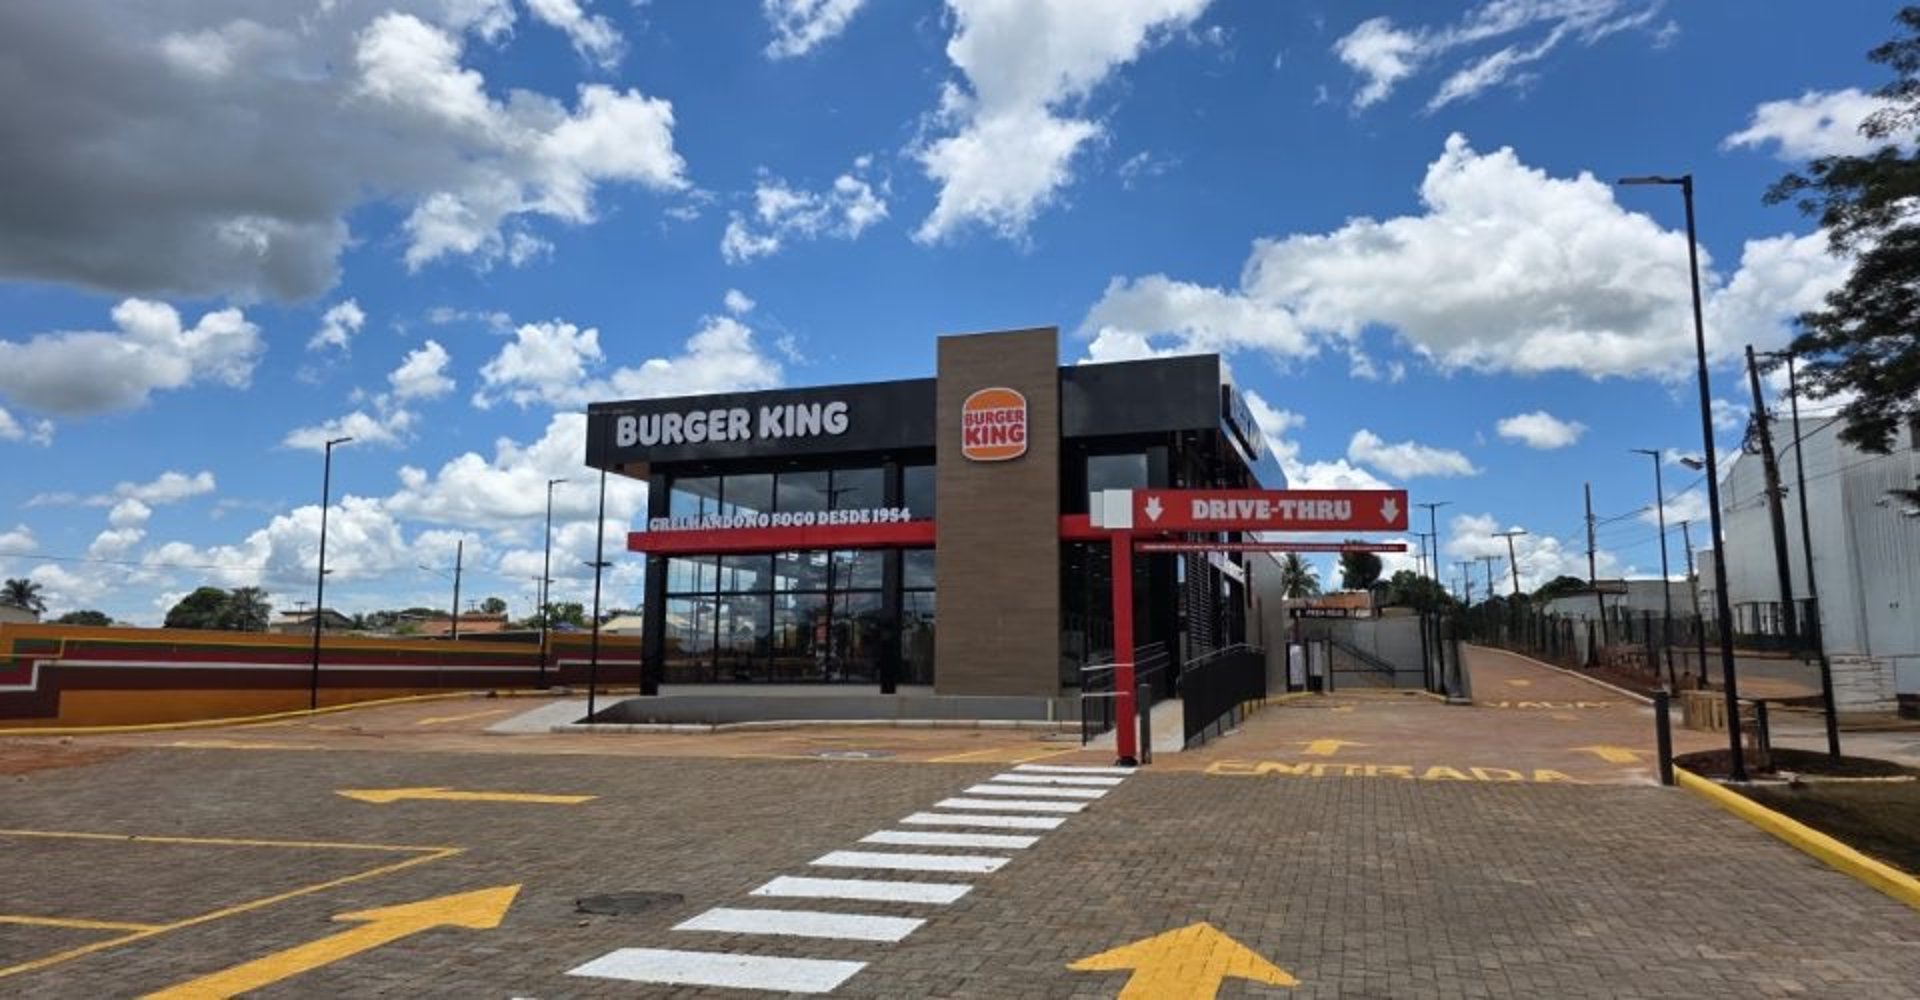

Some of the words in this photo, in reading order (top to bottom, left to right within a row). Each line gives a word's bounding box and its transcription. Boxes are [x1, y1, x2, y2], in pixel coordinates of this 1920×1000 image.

[616, 408, 750, 447] BURGER
[759, 402, 849, 439] KING
[964, 409, 1025, 427] BURGER
[965, 424, 1025, 446] KING
[744, 512, 769, 528] NO
[771, 510, 815, 527] FOGO
[817, 509, 872, 526] DESDE
[873, 507, 912, 523] 1954
[1191, 499, 1352, 520] DRIVE-THRU
[1203, 759, 1587, 785] ENTRADA
